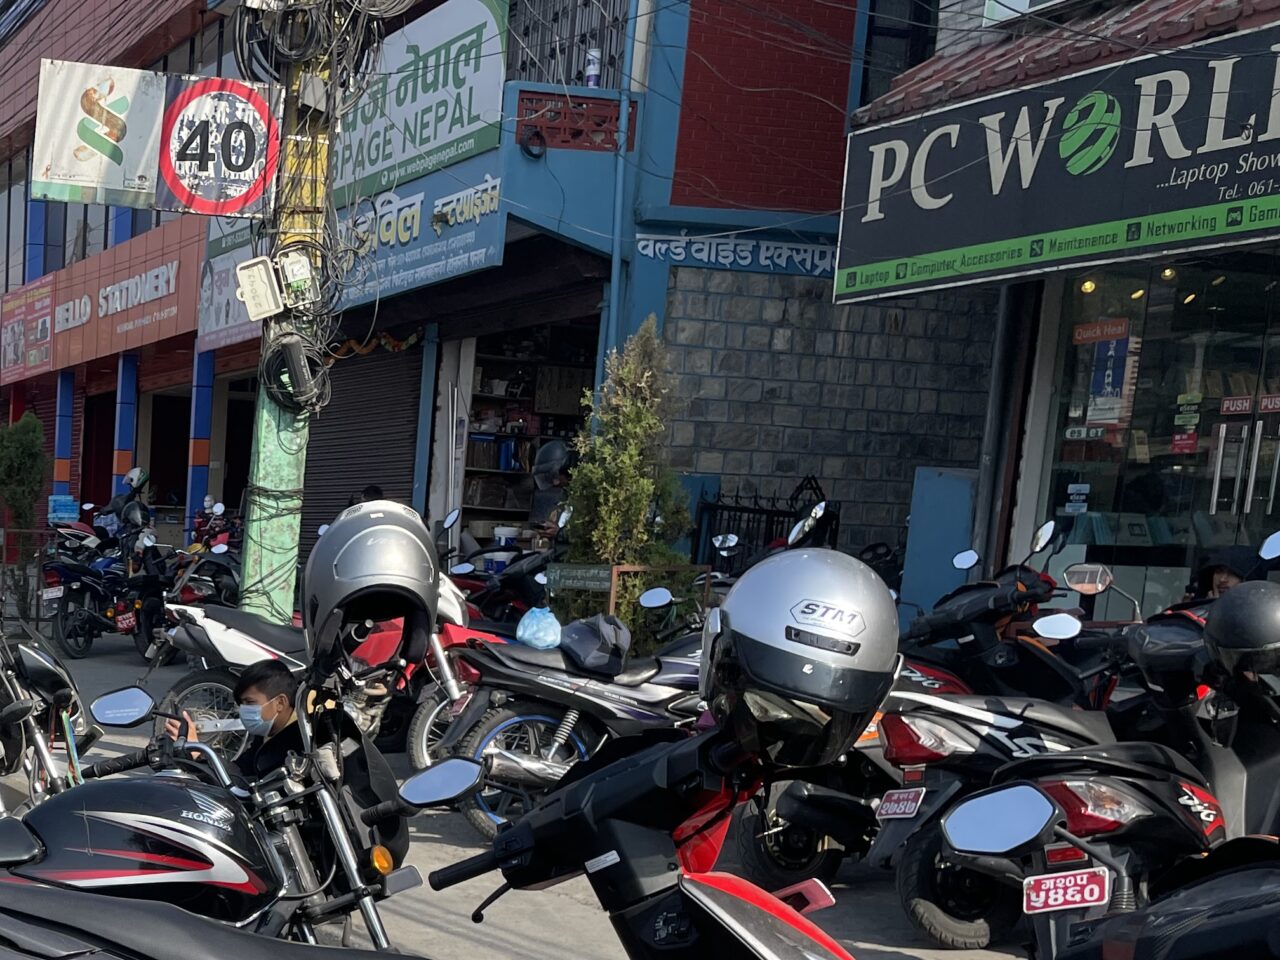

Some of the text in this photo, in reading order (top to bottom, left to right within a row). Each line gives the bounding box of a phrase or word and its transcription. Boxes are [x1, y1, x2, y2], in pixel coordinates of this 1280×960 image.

[396, 21, 487, 107] नेपाल
[176, 120, 256, 173] 40
[402, 86, 480, 153] NEPAL
[862, 43, 1280, 223] PC WORL
[1248, 178, 1280, 197] 061-
[860, 204, 1280, 286] Laptop Computer Accessories Maintenance Networking Gam
[98, 260, 180, 318] STATIONERY
[1075, 322, 1125, 340] Quick Heal
[1222, 399, 1250, 411] PUSH
[1261, 398, 1280, 410] PUS
